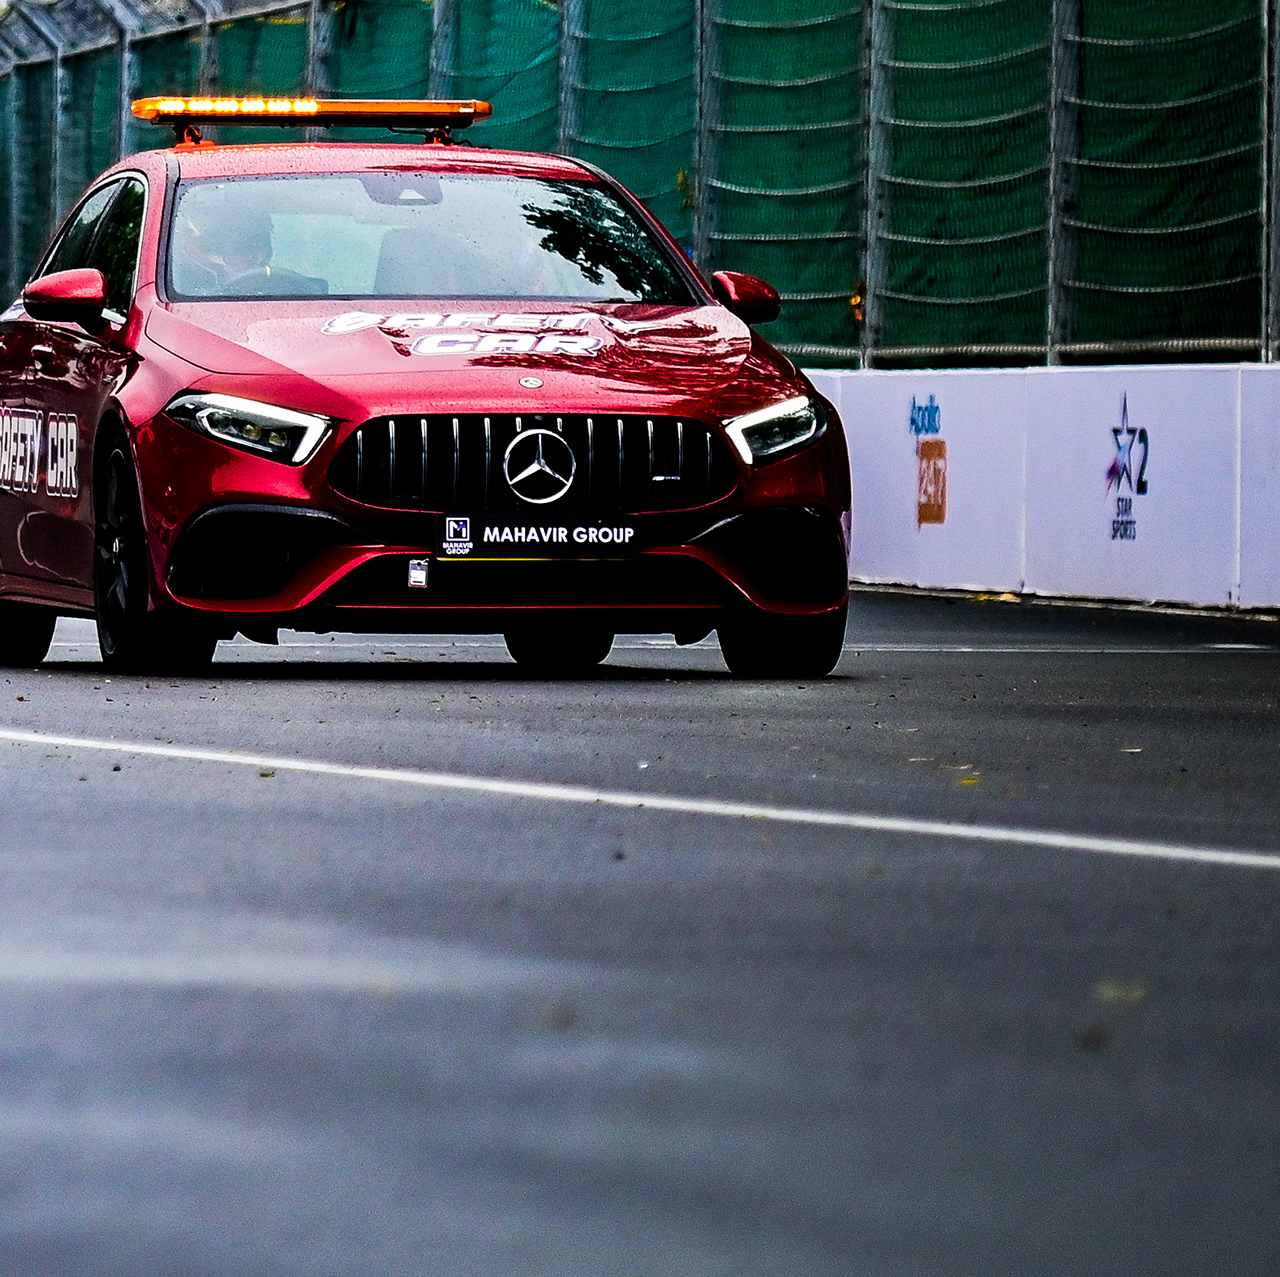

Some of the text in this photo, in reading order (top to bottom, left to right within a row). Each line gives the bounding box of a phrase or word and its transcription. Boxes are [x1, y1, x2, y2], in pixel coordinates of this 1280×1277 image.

[320, 311, 662, 335] SAFETY
[410, 334, 604, 356] CAR
[46, 412, 79, 498] CAR
[1136, 427, 1149, 495] 2
[483, 526, 634, 543] MAHAVIR GROUP
[1111, 520, 1137, 540] SPORTS
